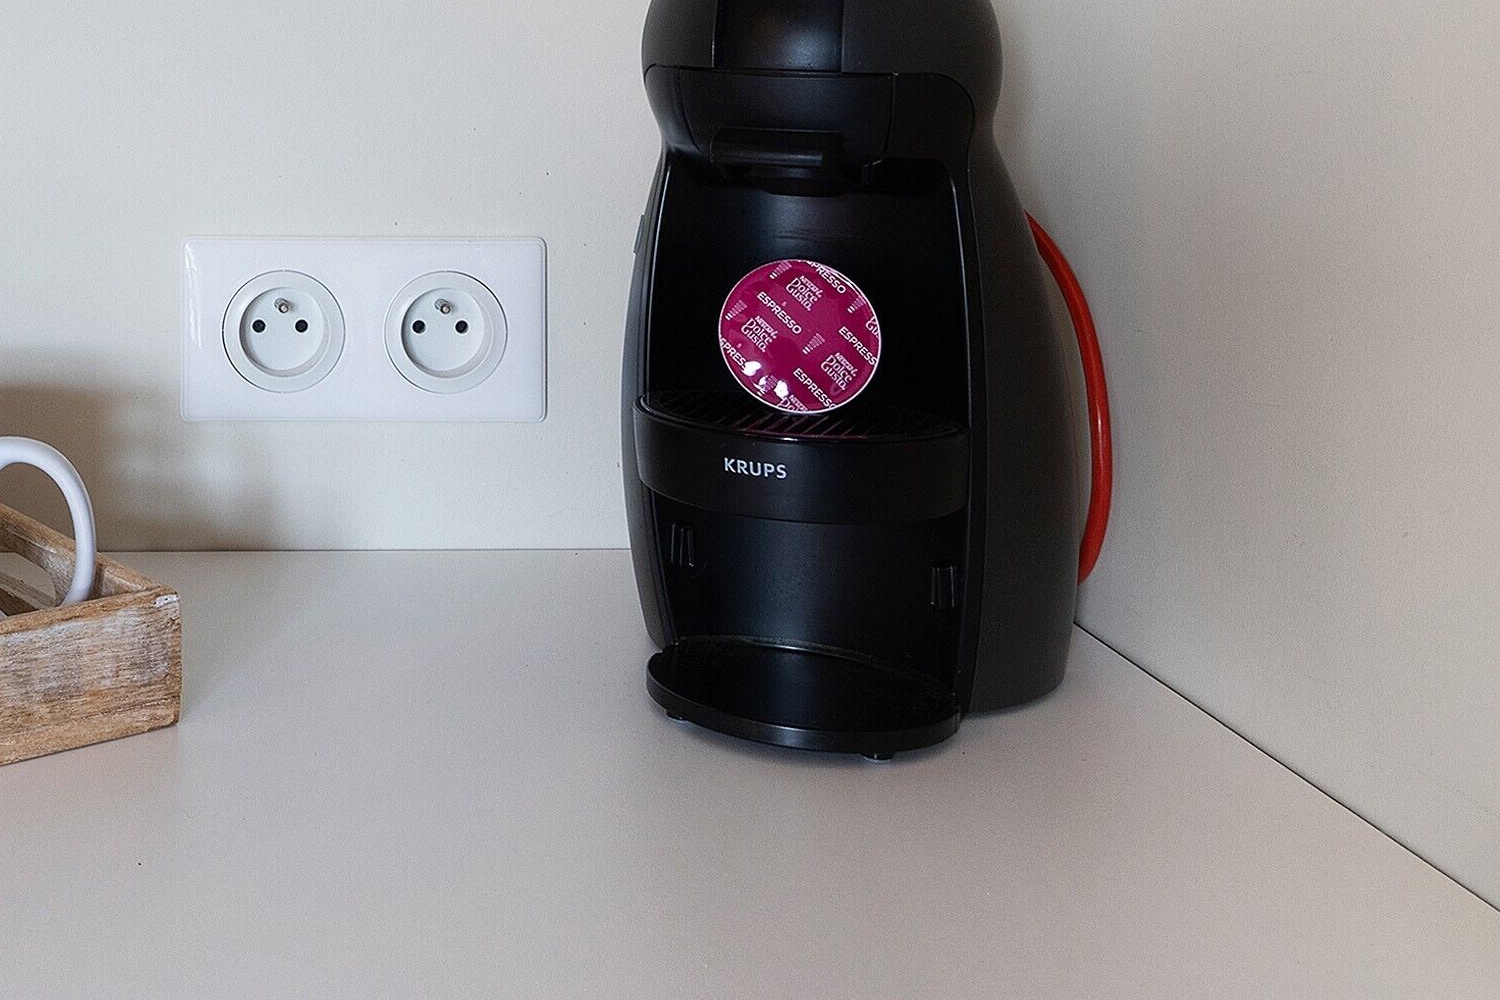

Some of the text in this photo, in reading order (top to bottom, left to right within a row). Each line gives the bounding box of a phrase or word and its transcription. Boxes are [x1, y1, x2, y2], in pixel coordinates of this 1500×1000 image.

[806, 260, 846, 294] PRESSO
[756, 291, 802, 335] ESPRESSO
[838, 326, 878, 365] ESPRESS
[724, 457, 787, 478] KRUPS
